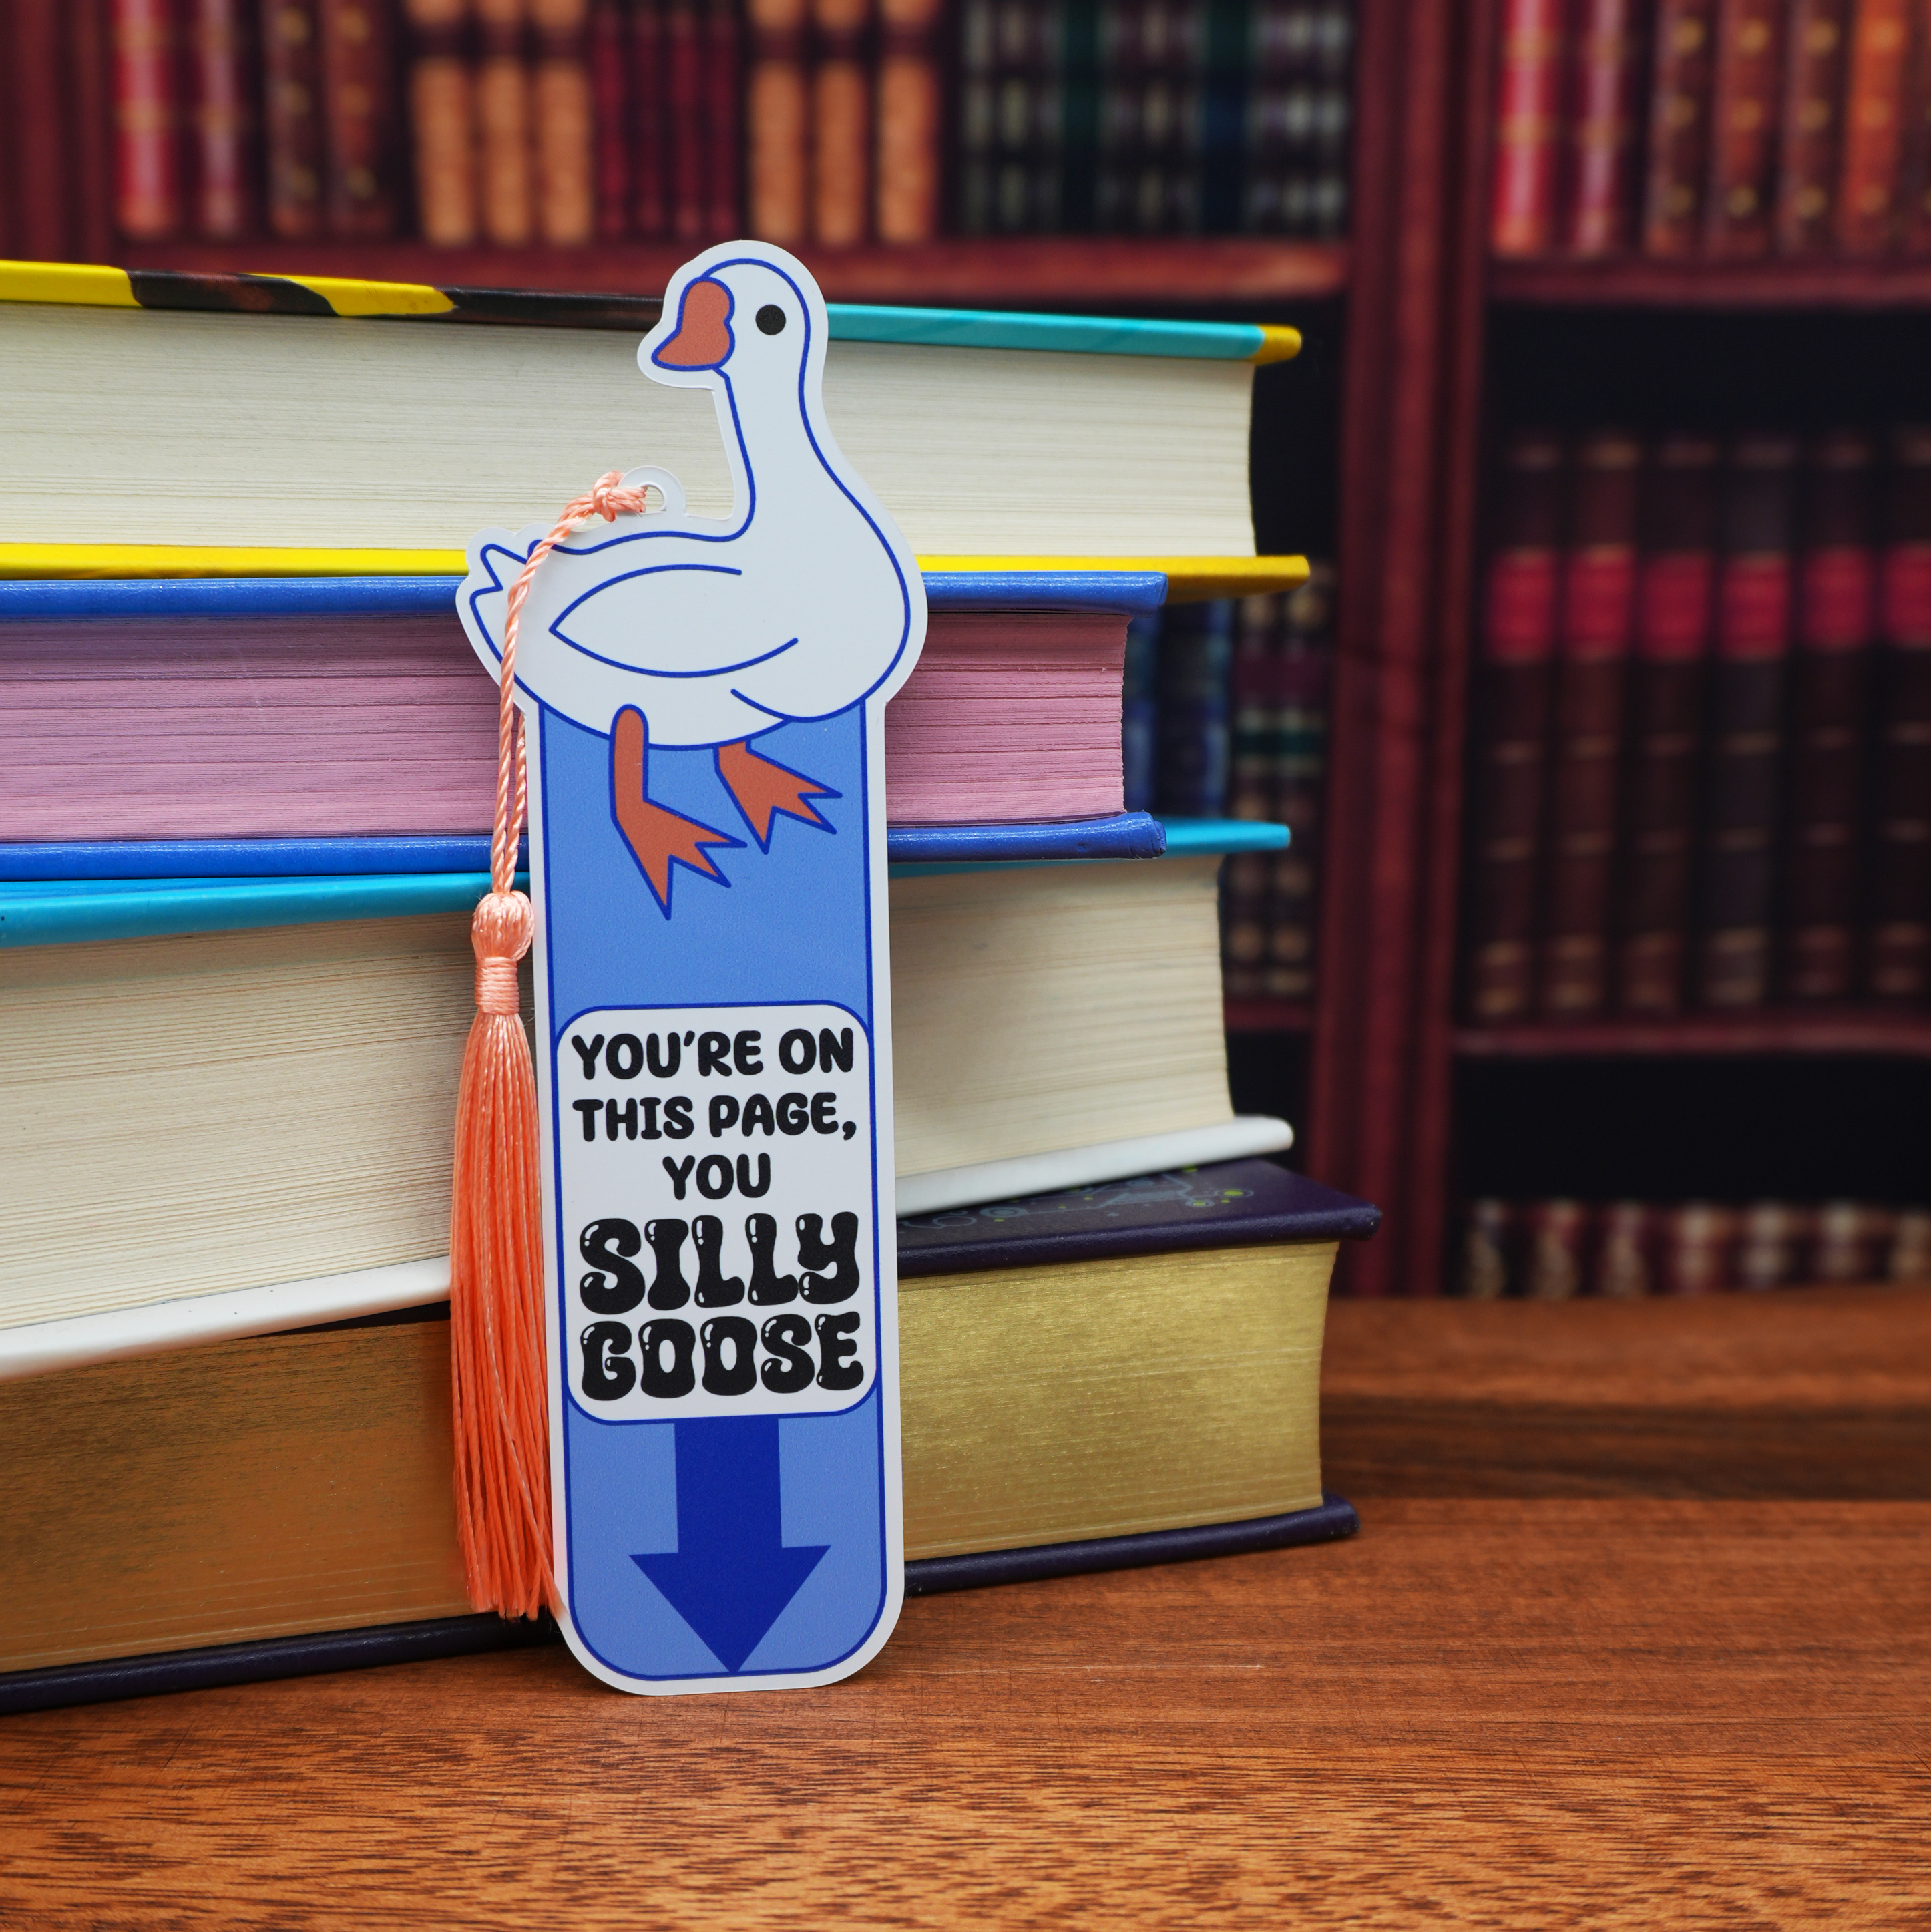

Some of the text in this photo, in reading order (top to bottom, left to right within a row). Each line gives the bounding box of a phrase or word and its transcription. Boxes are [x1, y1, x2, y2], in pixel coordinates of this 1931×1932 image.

[572, 1028, 853, 1080] YOU'RE ON
[572, 1092, 857, 1142] THIS PAGE,
[662, 1153, 771, 1201] YOU
[579, 1211, 860, 1315] SILLY
[580, 1311, 864, 1401] GOOSE
